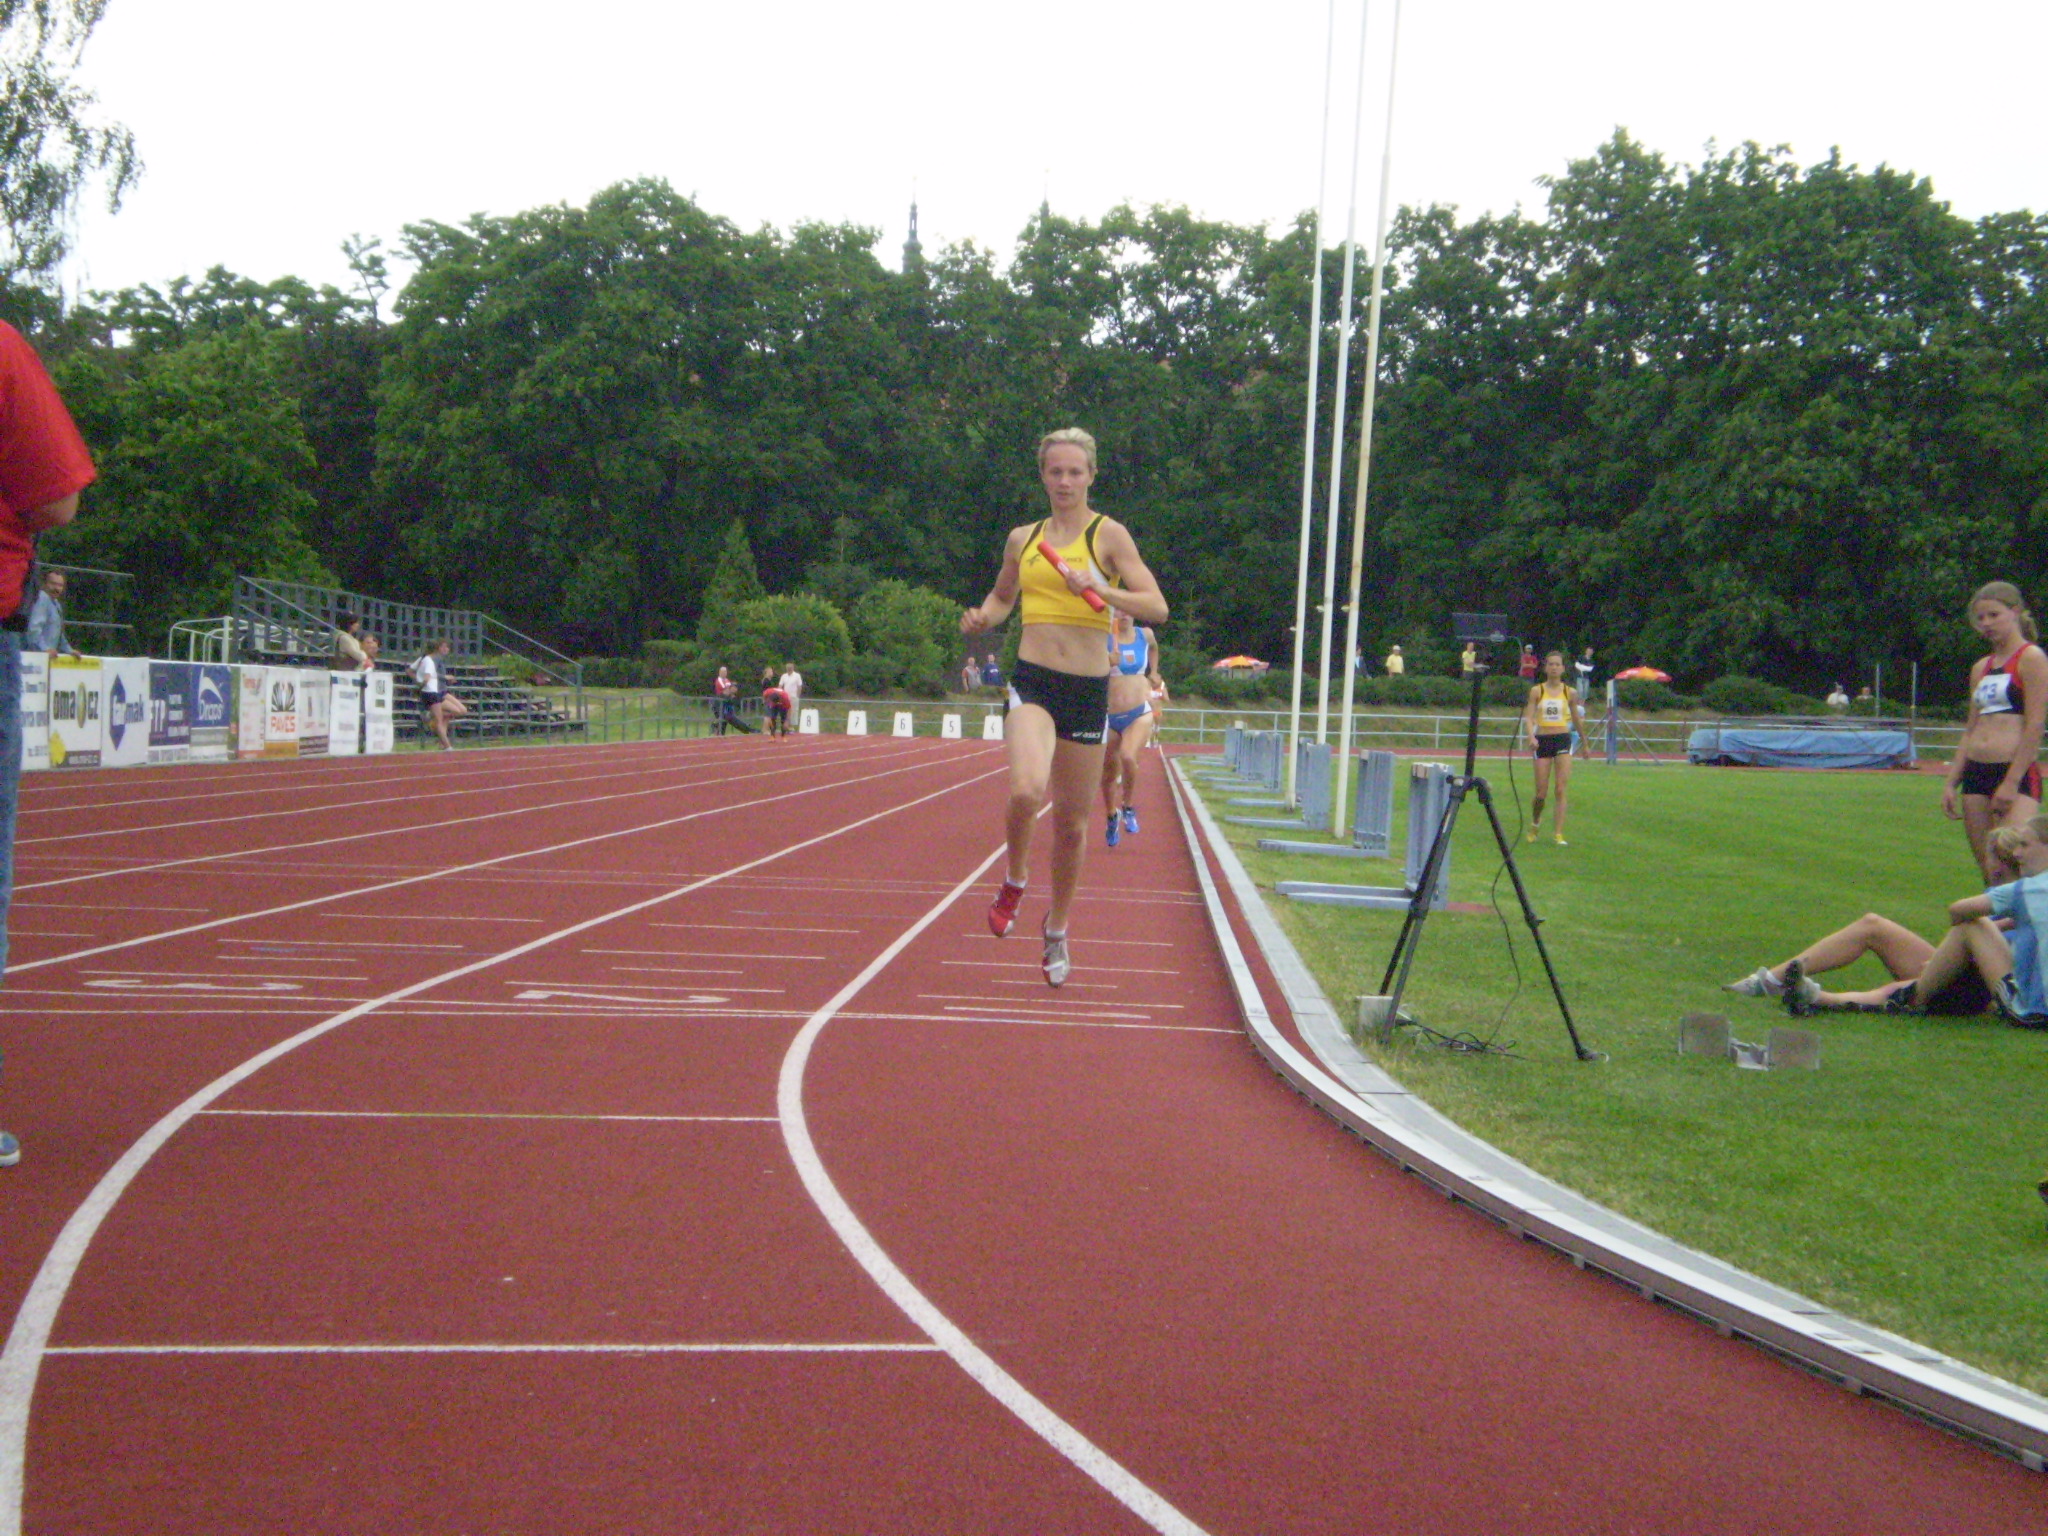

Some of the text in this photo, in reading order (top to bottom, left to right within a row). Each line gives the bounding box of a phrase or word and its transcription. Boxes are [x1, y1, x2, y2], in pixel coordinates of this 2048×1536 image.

[1547, 706, 1558, 715] 63
[806, 714, 811, 727] 8
[854, 715, 860, 728] 7
[900, 717, 906, 730] 6
[949, 719, 955, 733] 5
